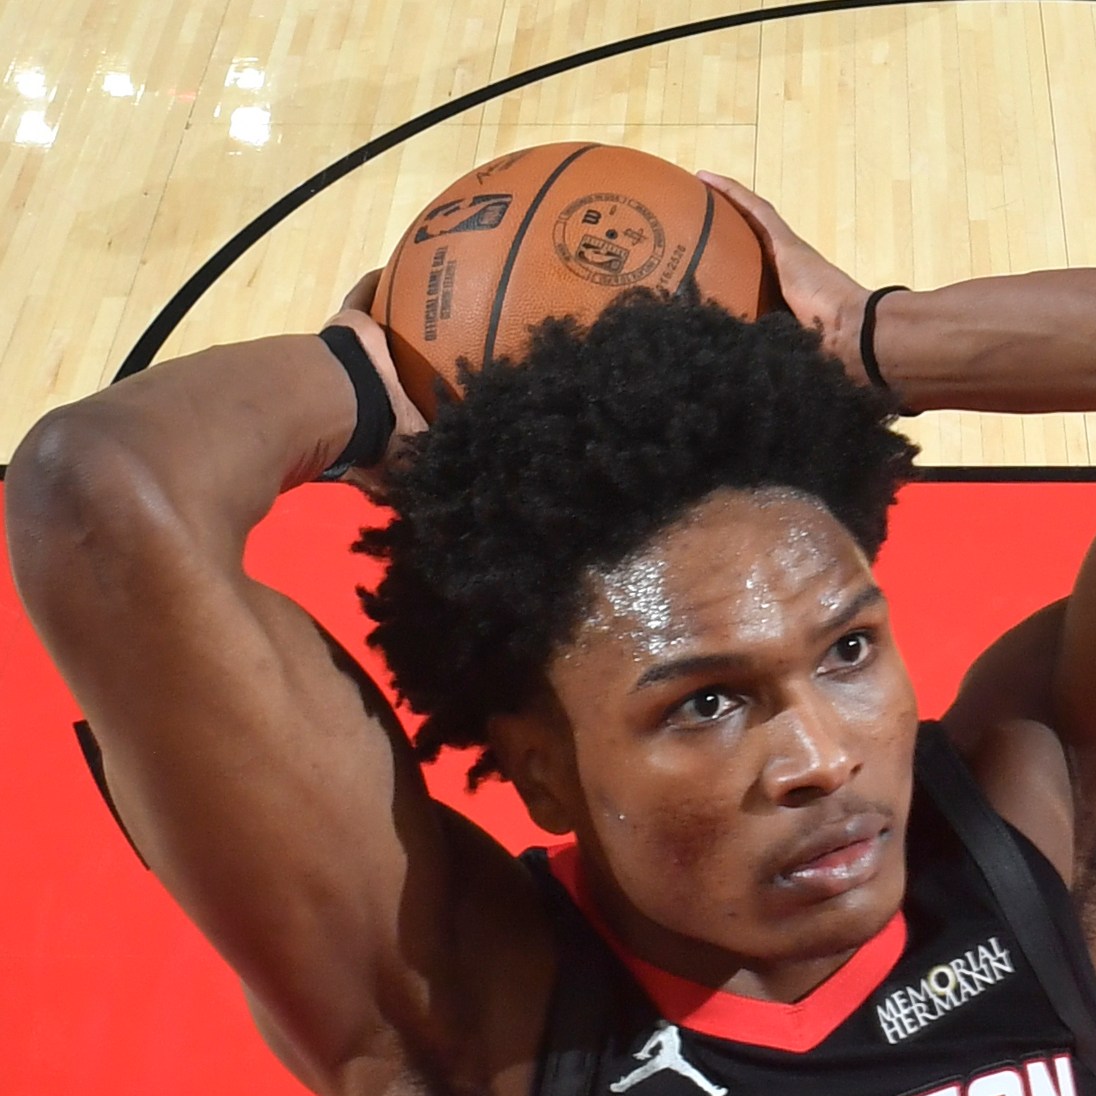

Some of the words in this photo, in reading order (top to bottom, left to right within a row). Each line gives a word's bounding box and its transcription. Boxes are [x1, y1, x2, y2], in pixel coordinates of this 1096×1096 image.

[431, 245, 449, 269] BALL
[426, 267, 444, 296] GAME
[424, 296, 439, 342] OFFICIAL
[876, 937, 1007, 1024] MEMORIAL
[881, 949, 1016, 1044] HERMANN
